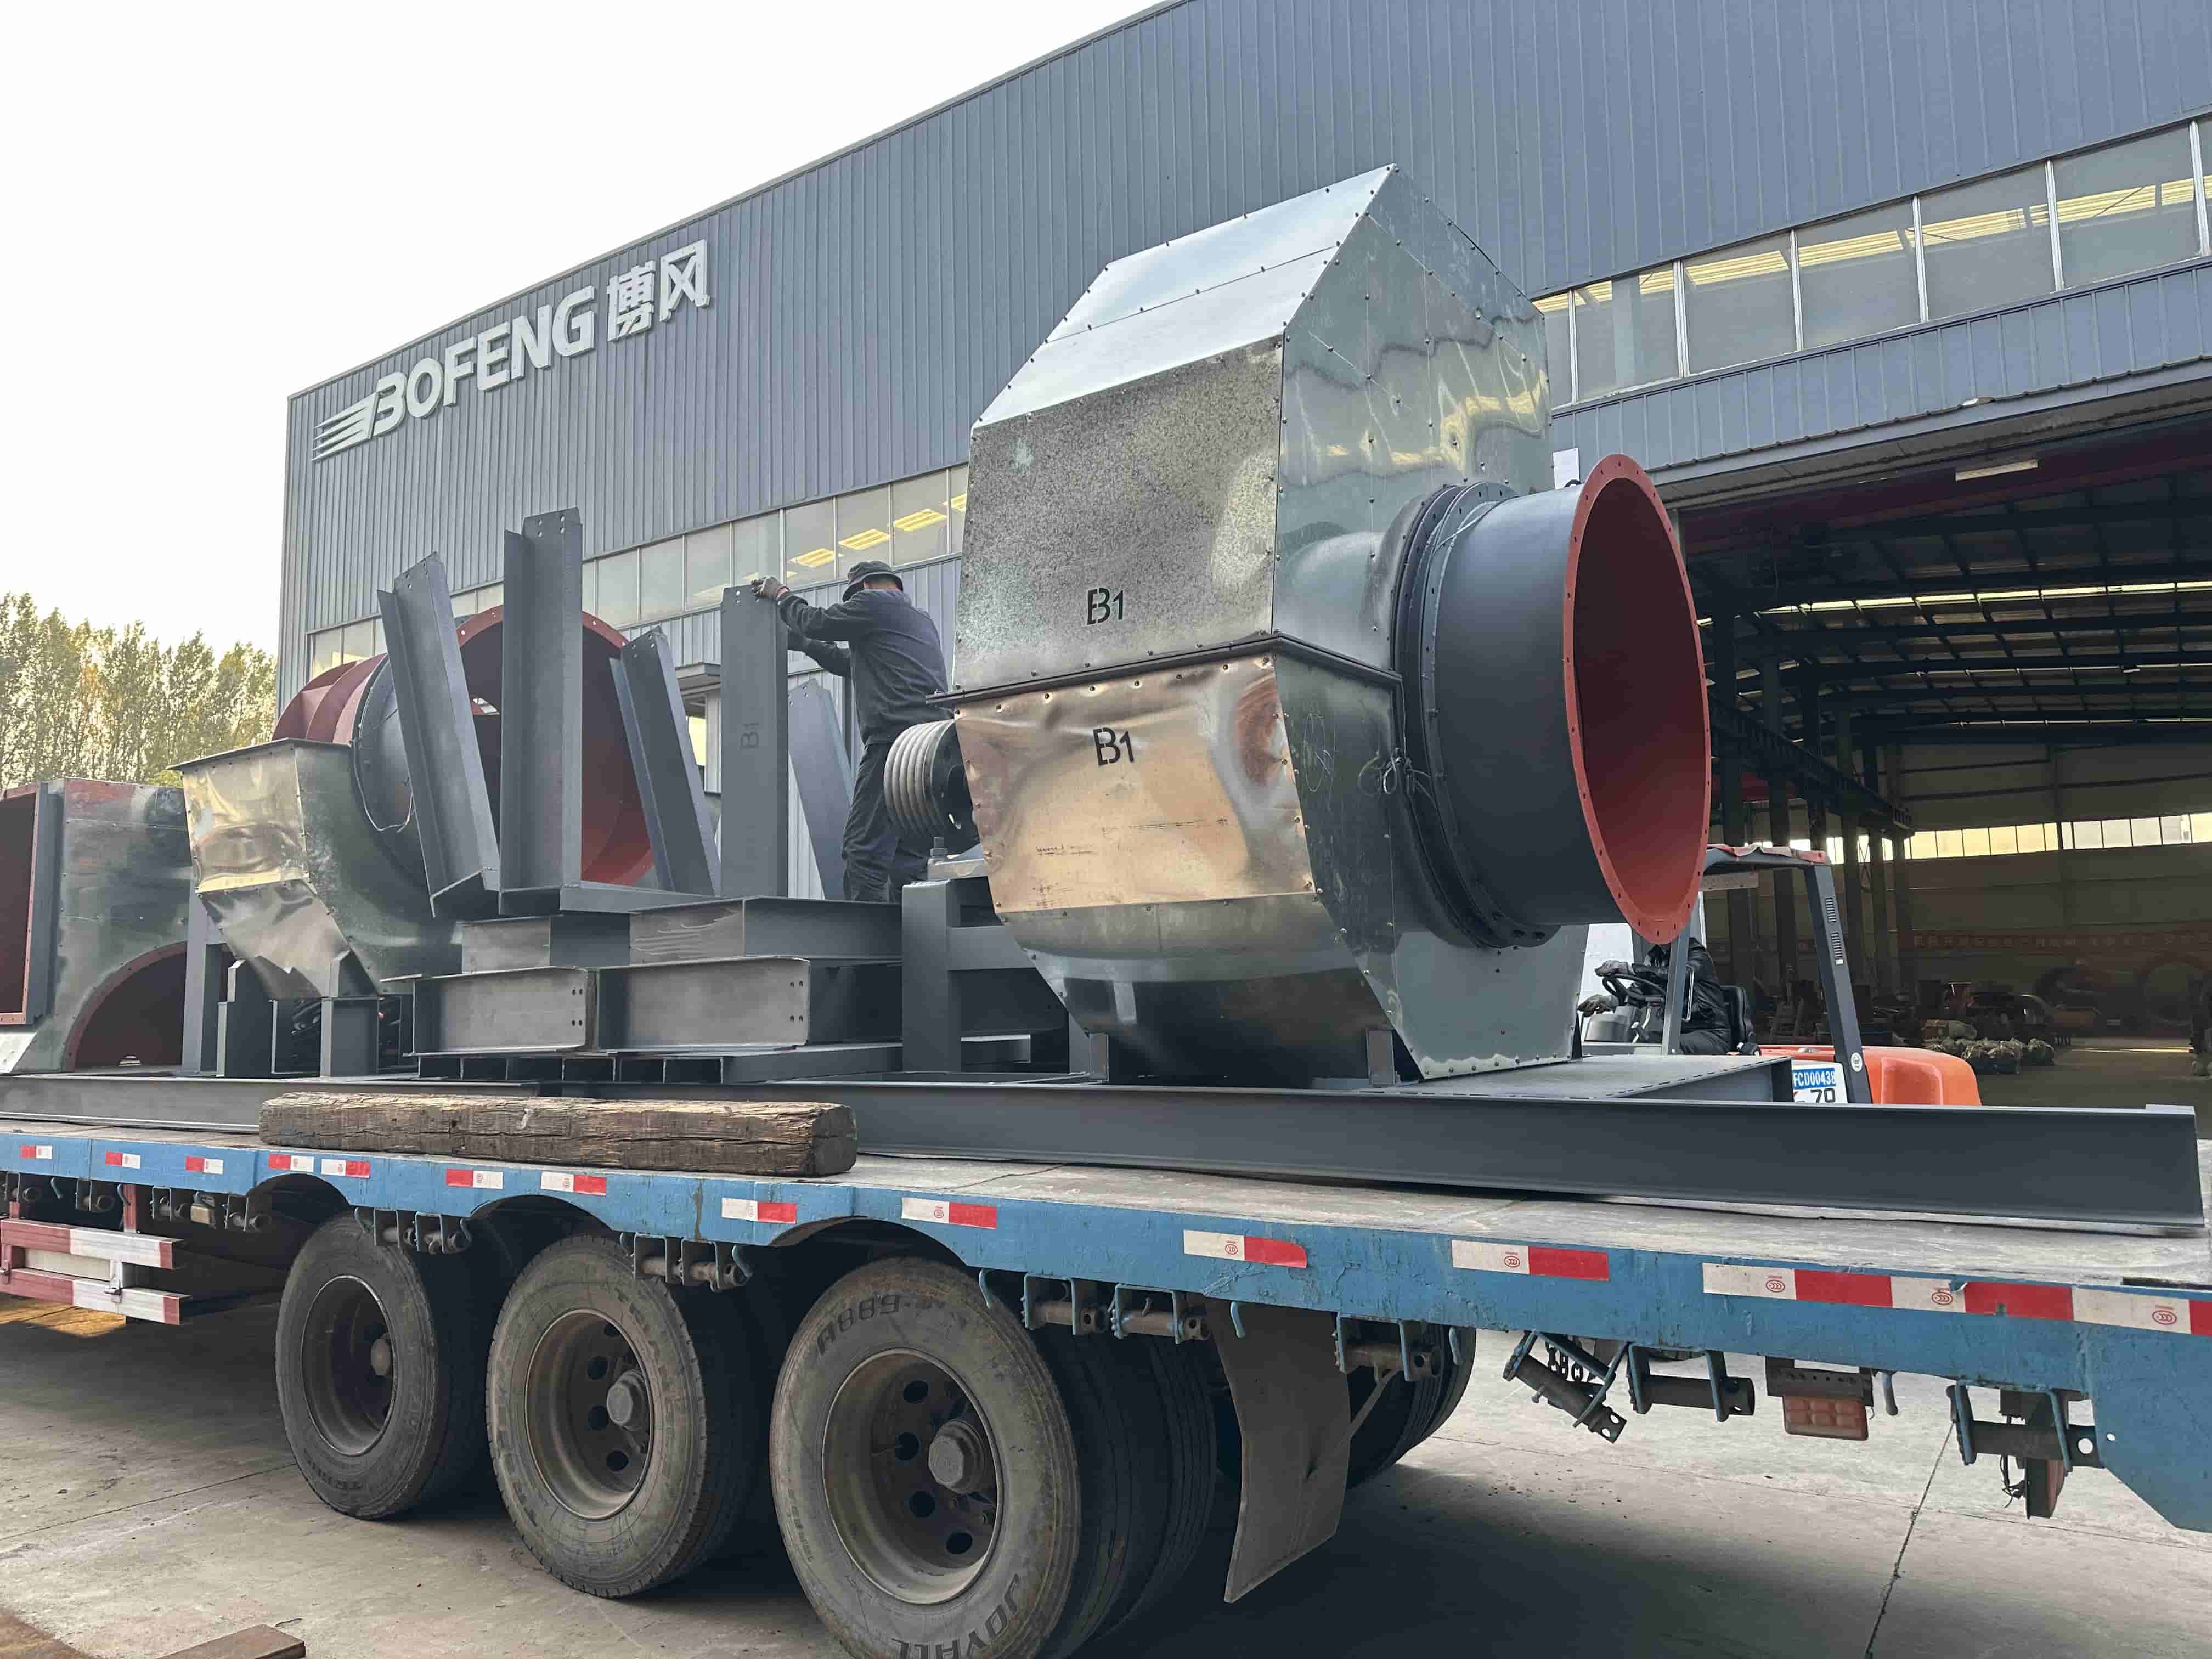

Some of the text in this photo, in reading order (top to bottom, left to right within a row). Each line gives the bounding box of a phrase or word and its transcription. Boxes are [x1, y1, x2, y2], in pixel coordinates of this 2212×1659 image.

[366, 239, 711, 440] BOFENG 博风
[1087, 588, 1124, 625] B1
[1092, 727, 1135, 766] B1
